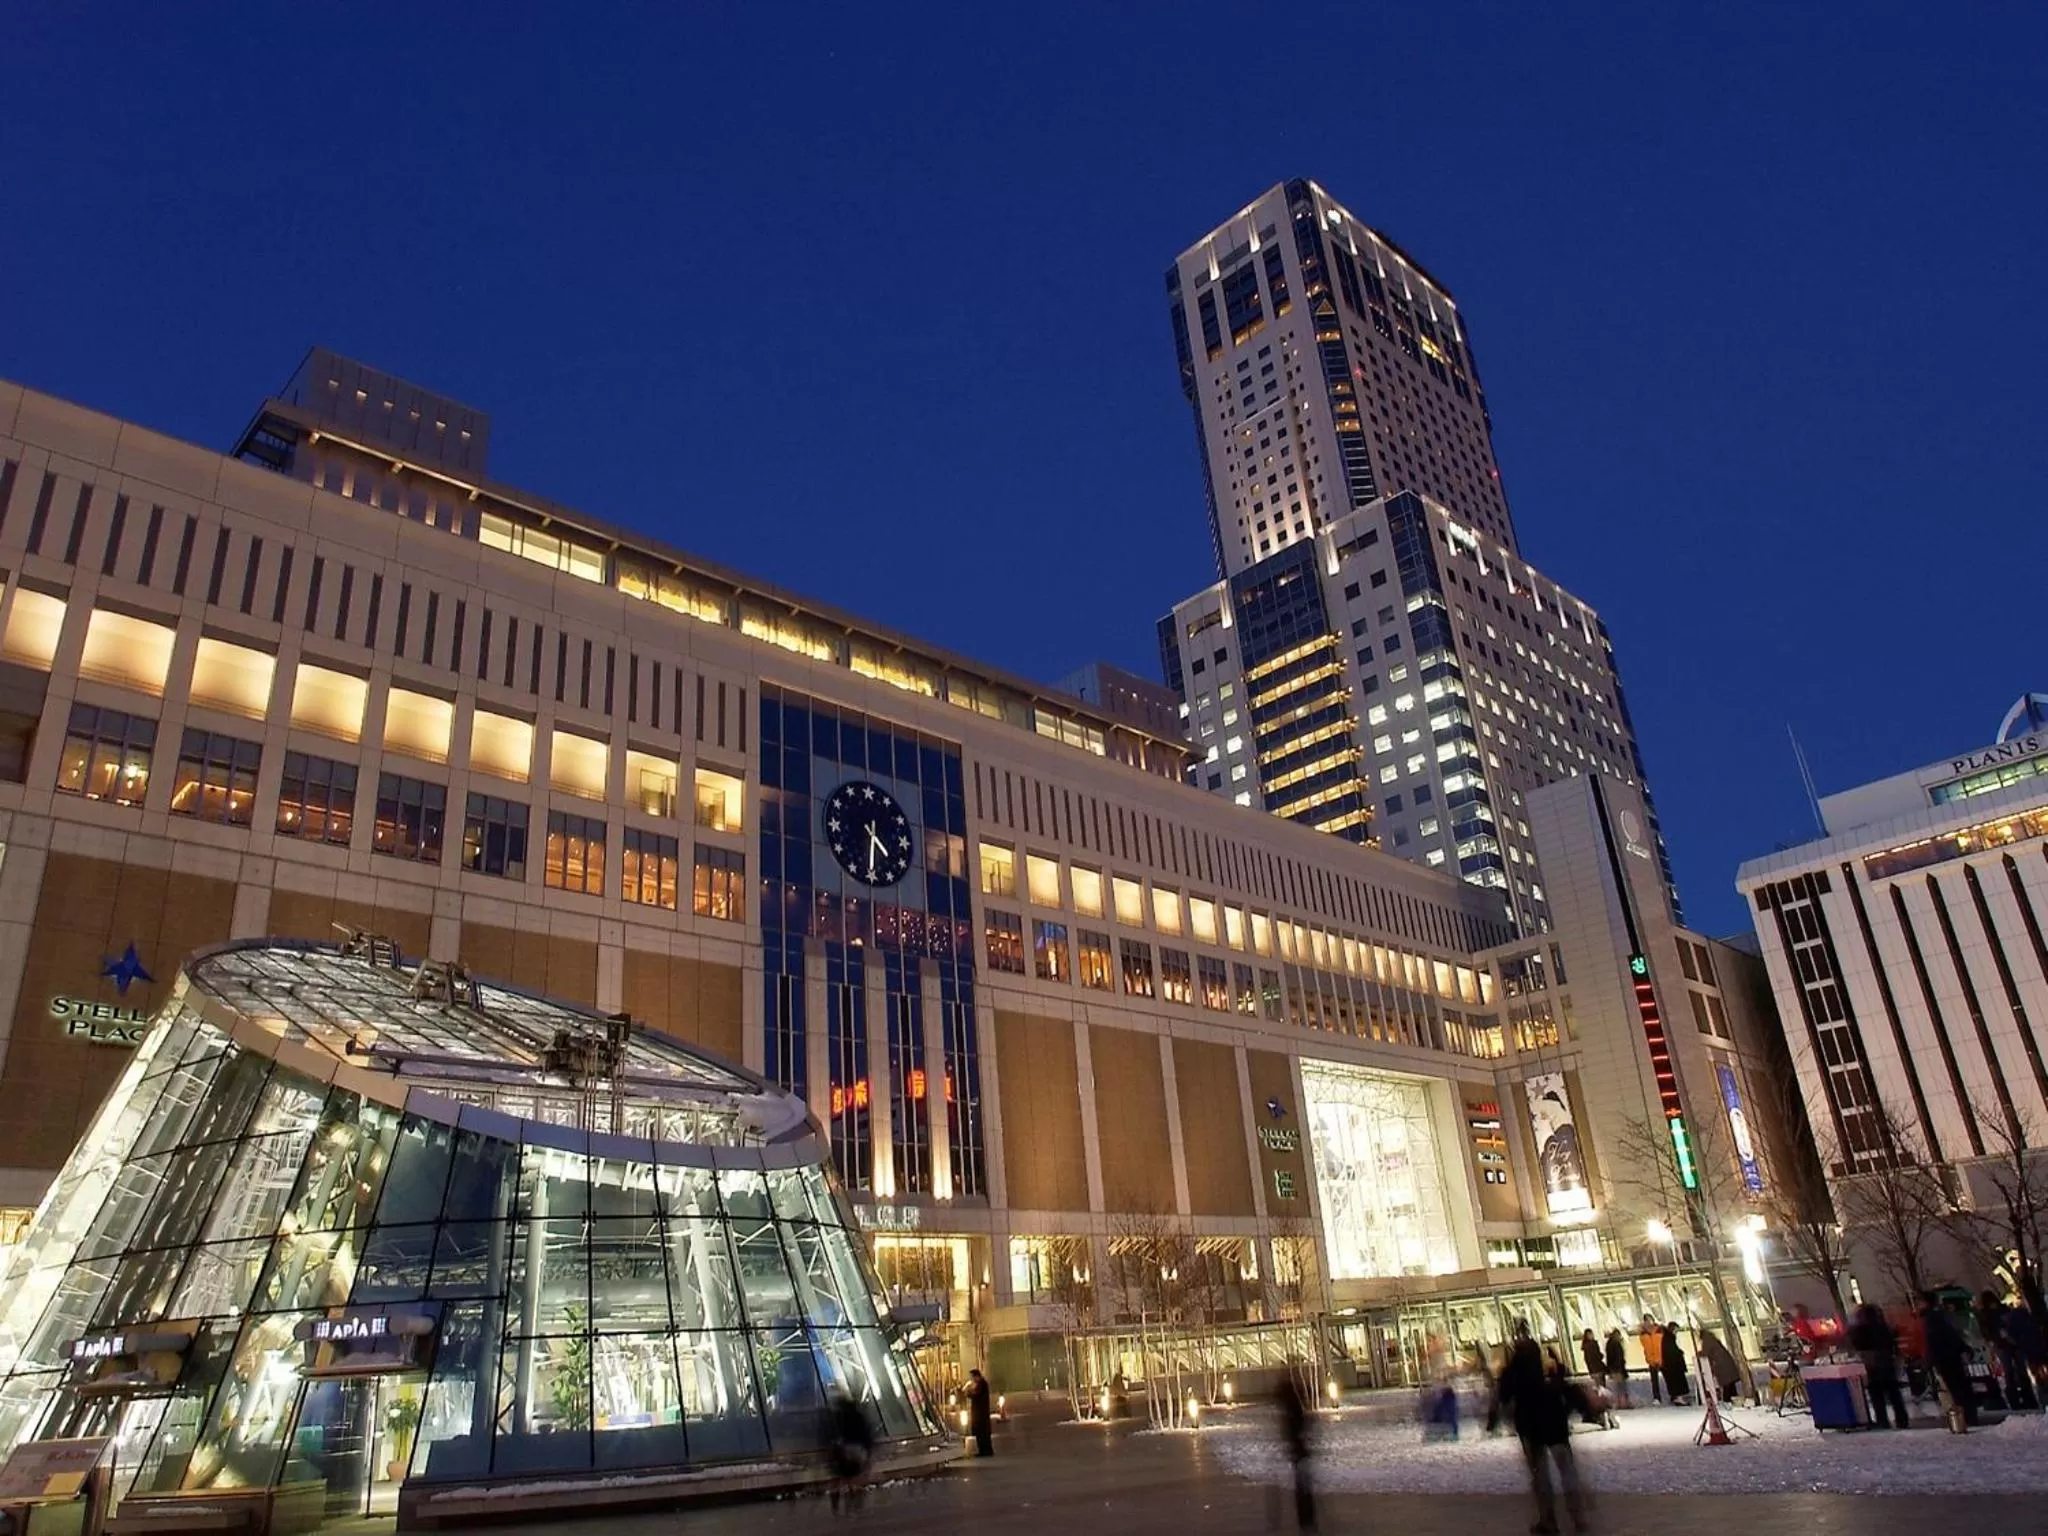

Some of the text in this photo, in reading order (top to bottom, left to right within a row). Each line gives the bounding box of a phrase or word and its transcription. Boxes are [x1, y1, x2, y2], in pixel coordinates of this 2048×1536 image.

[1952, 737, 2039, 773] PLANIS
[51, 997, 148, 1022] STELL
[67, 1019, 145, 1041] PLAC
[332, 1316, 369, 1339] APIA
